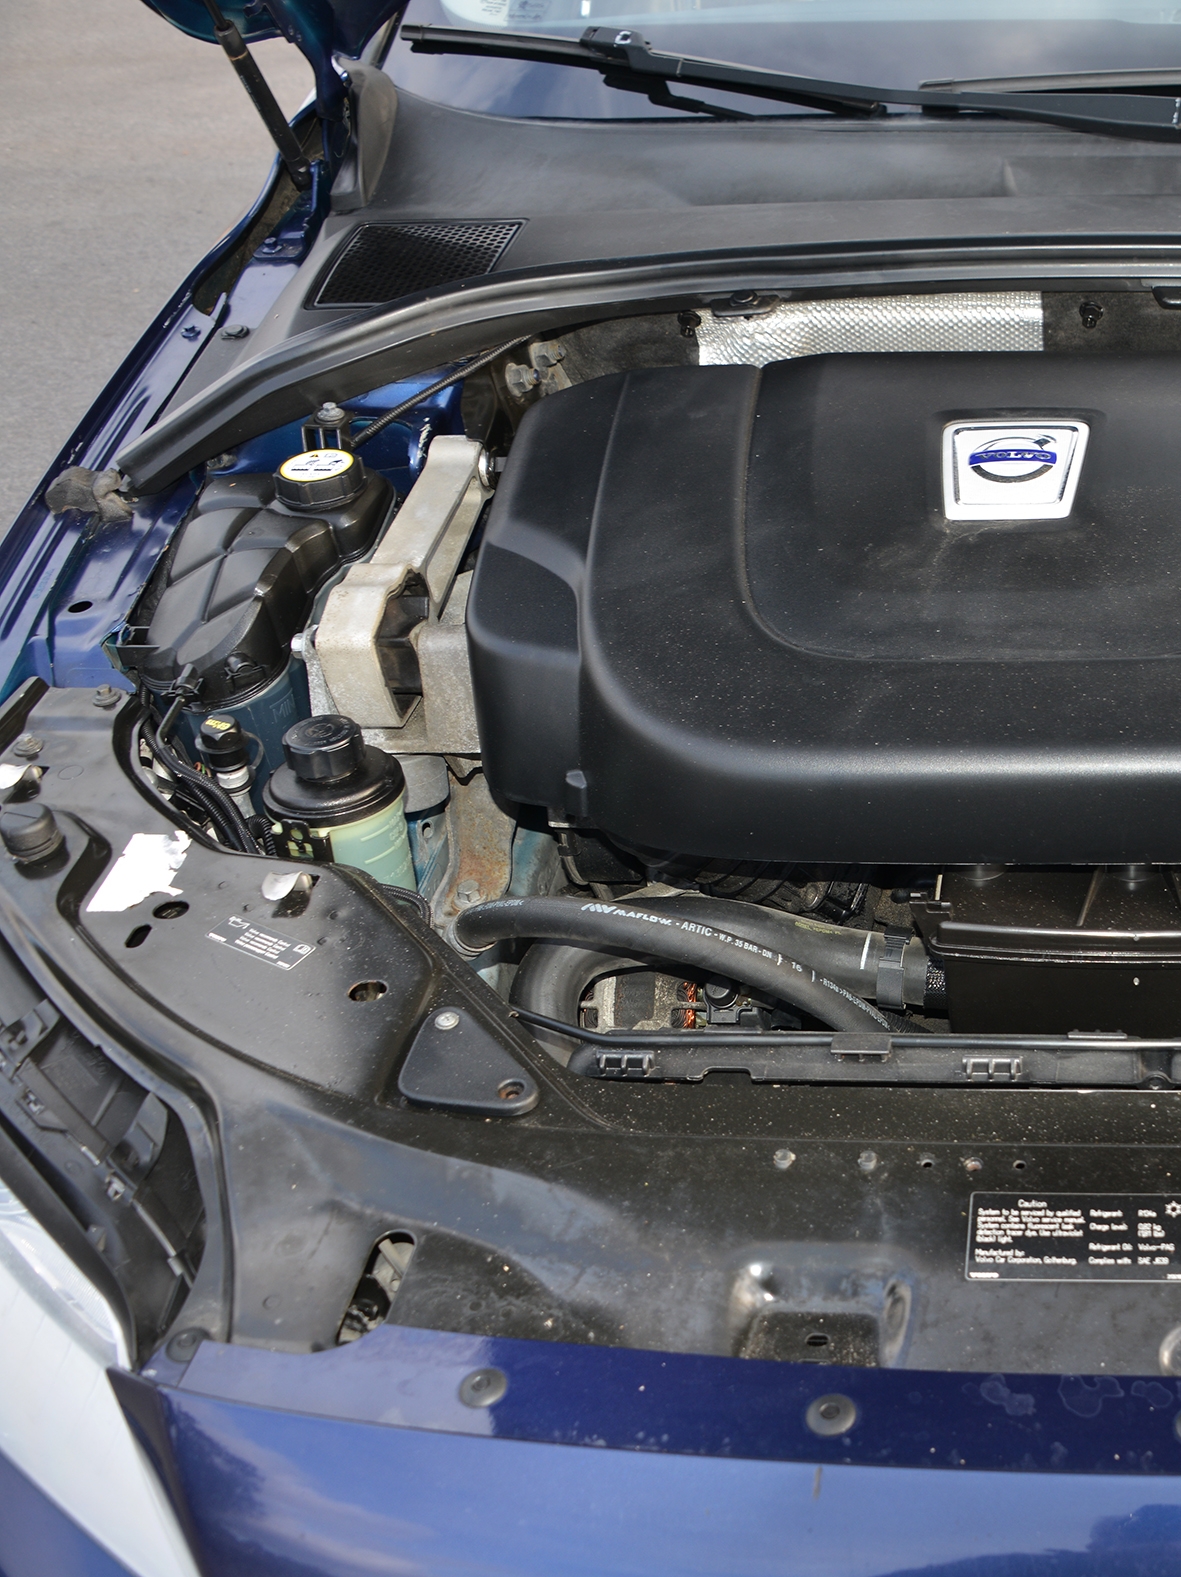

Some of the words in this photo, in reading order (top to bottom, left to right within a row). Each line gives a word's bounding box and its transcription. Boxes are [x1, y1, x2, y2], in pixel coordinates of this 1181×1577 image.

[975, 451, 1052, 460] VOLVO
[681, 921, 713, 937] ARTIC
[734, 939, 743, 948] 35
[791, 961, 803, 973] 16
[1017, 1198, 1048, 1208] Caution
